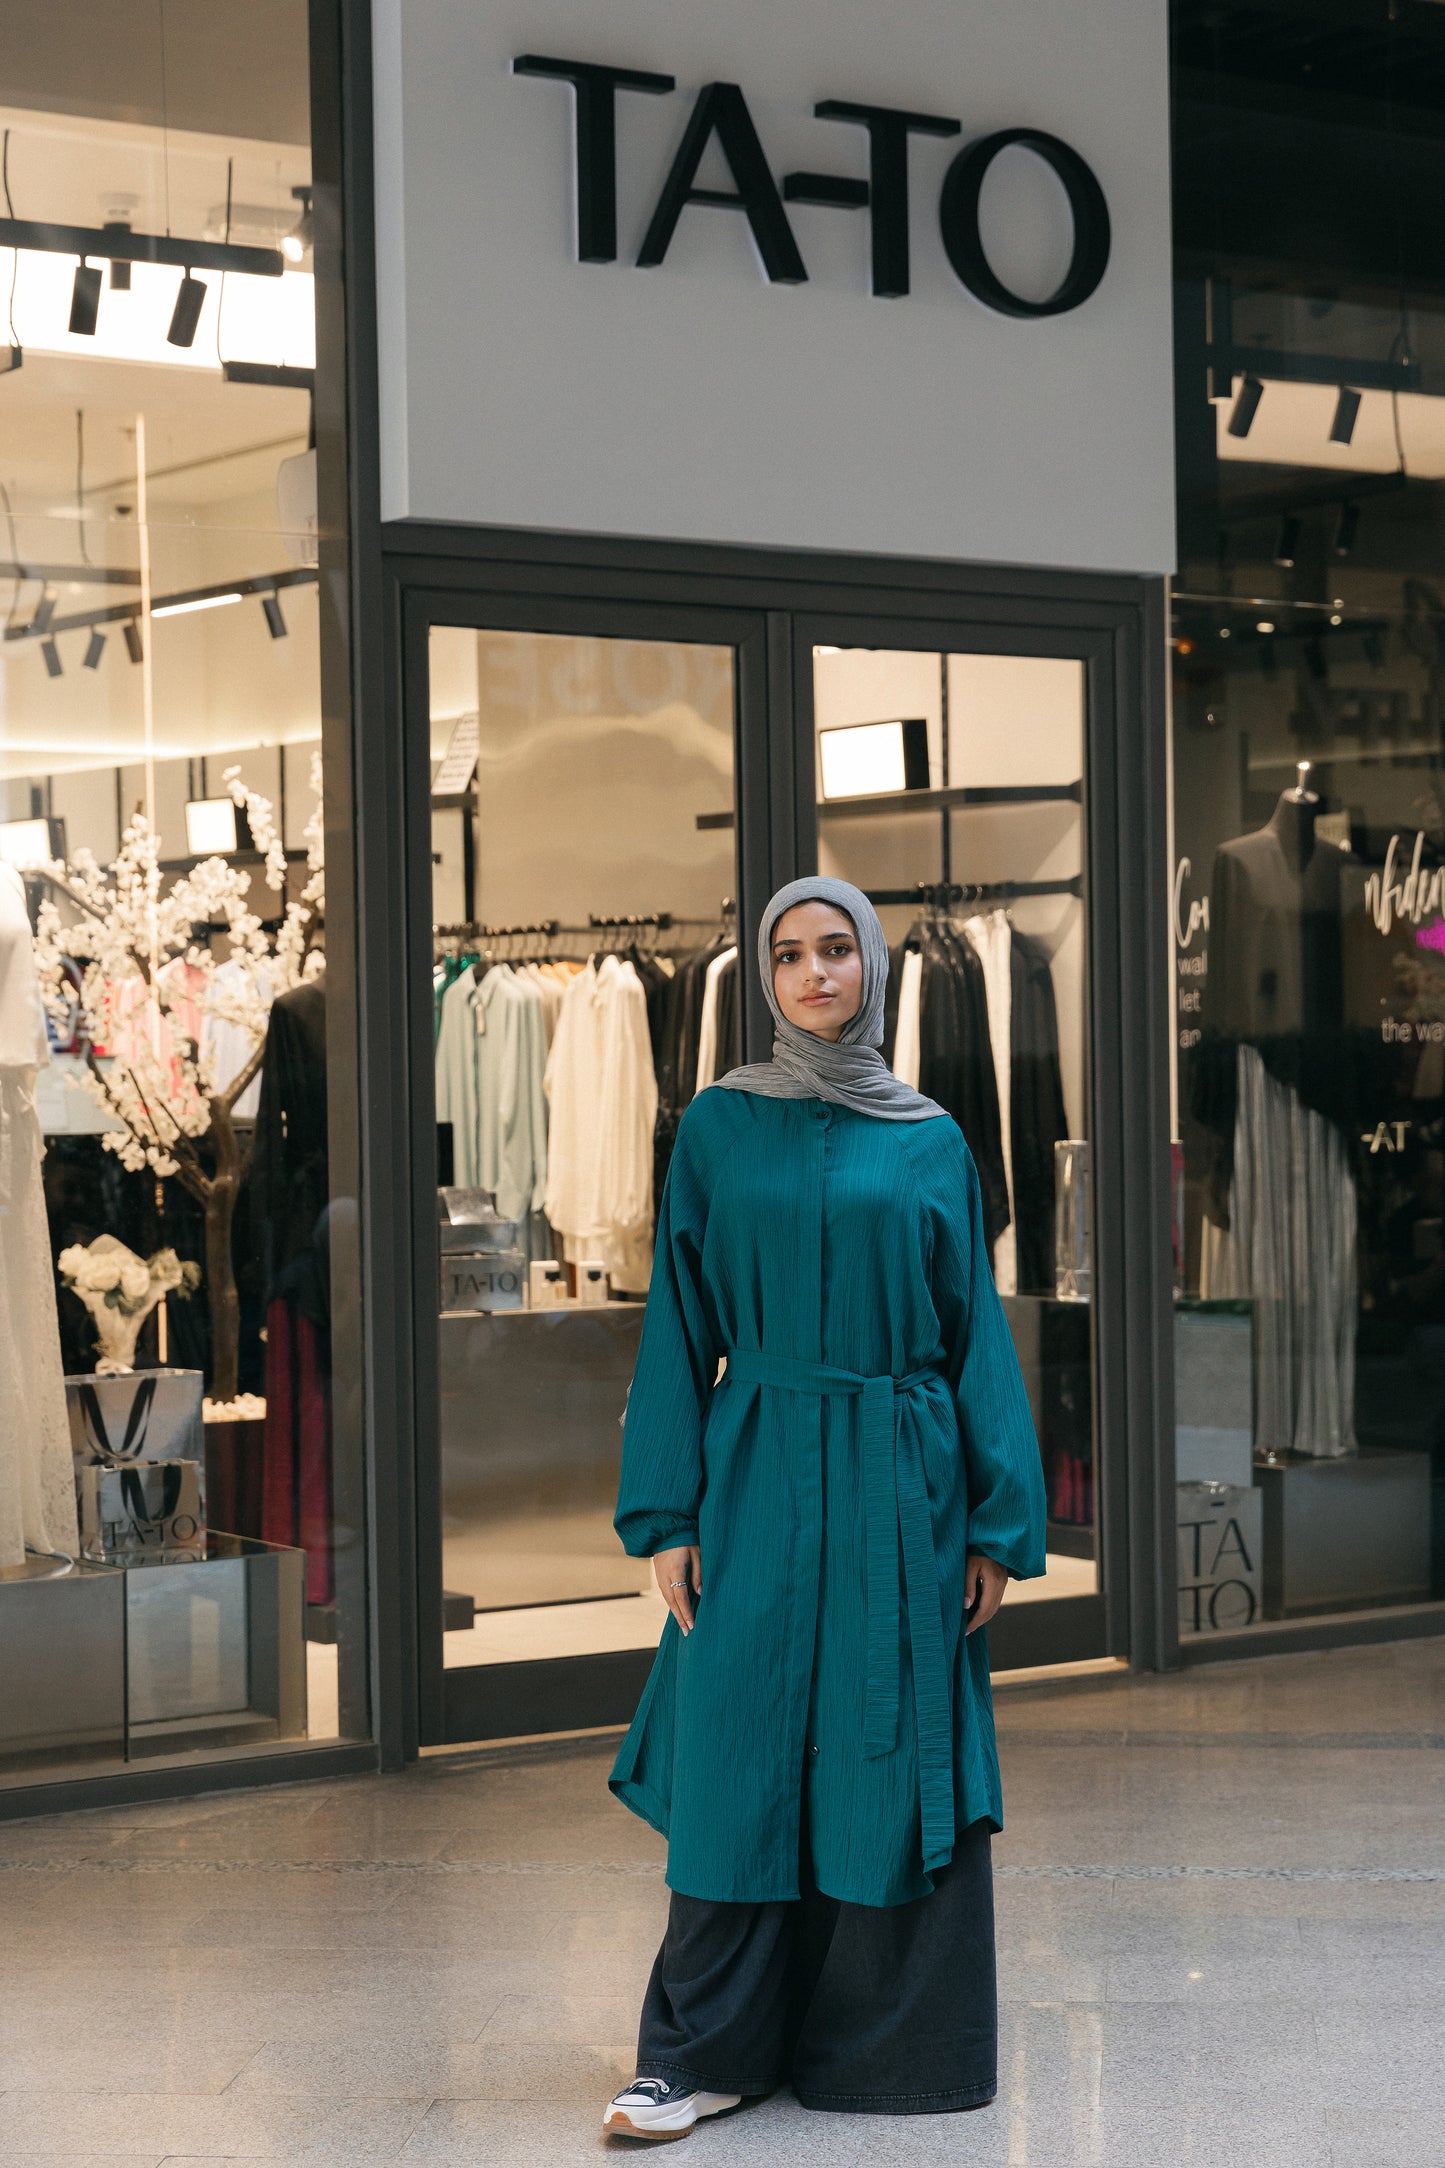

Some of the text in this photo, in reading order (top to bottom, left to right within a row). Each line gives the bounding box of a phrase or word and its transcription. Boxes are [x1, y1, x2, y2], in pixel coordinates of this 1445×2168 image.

[511, 53, 1111, 320] TA-TO
[1381, 1016, 1412, 1043] the
[1415, 1021, 1445, 1043] wa
[1178, 1517, 1254, 1577] TA
